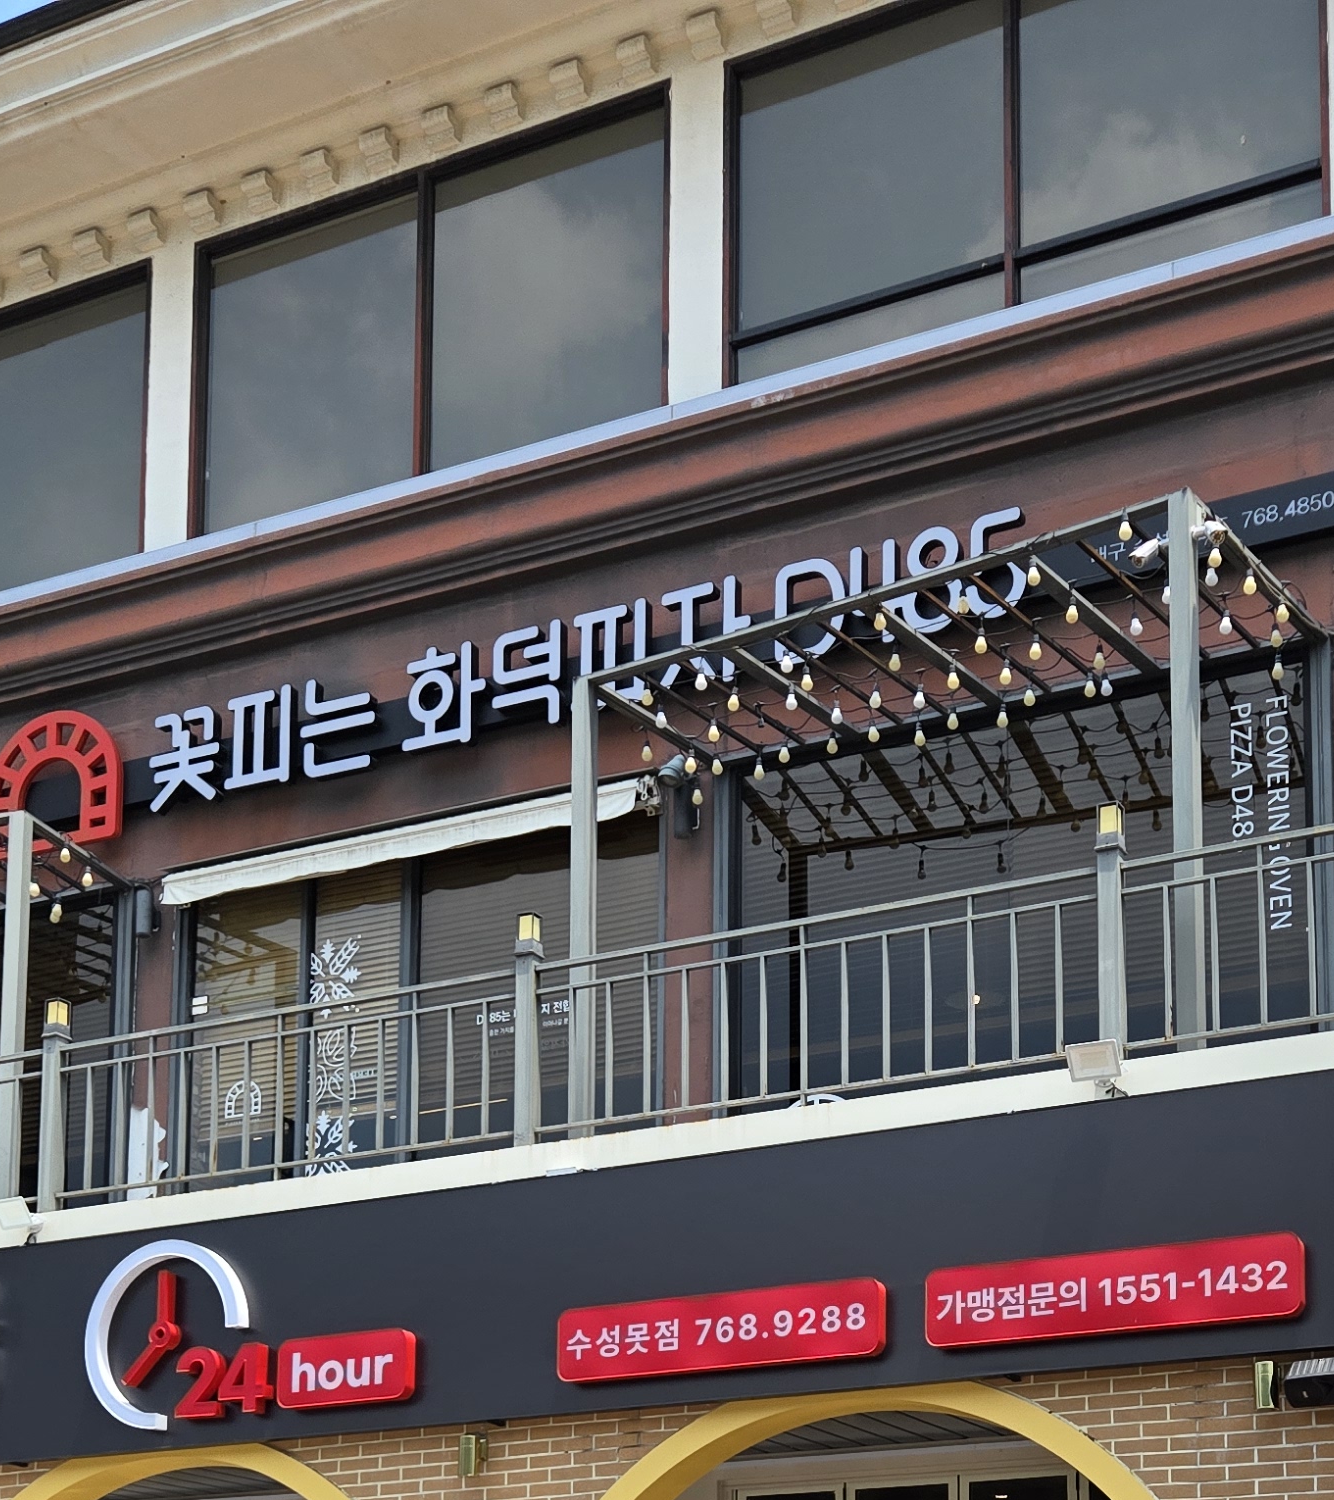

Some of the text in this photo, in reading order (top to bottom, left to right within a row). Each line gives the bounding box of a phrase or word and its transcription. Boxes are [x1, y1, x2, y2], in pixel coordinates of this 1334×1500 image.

[150, 680, 376, 812] 꽃피는
[403, 574, 751, 752] 화덕피자
[1230, 702, 1255, 845] PIZZA D48
[1265, 694, 1293, 931] FLOWERIN OVEN
[476, 1010, 511, 1026] D85는
[566, 1301, 867, 1361] 수성못점 768.9288
[936, 1259, 1289, 1327] 가맹점문의 1551-1432
[174, 1342, 393, 1420] 24 hour
